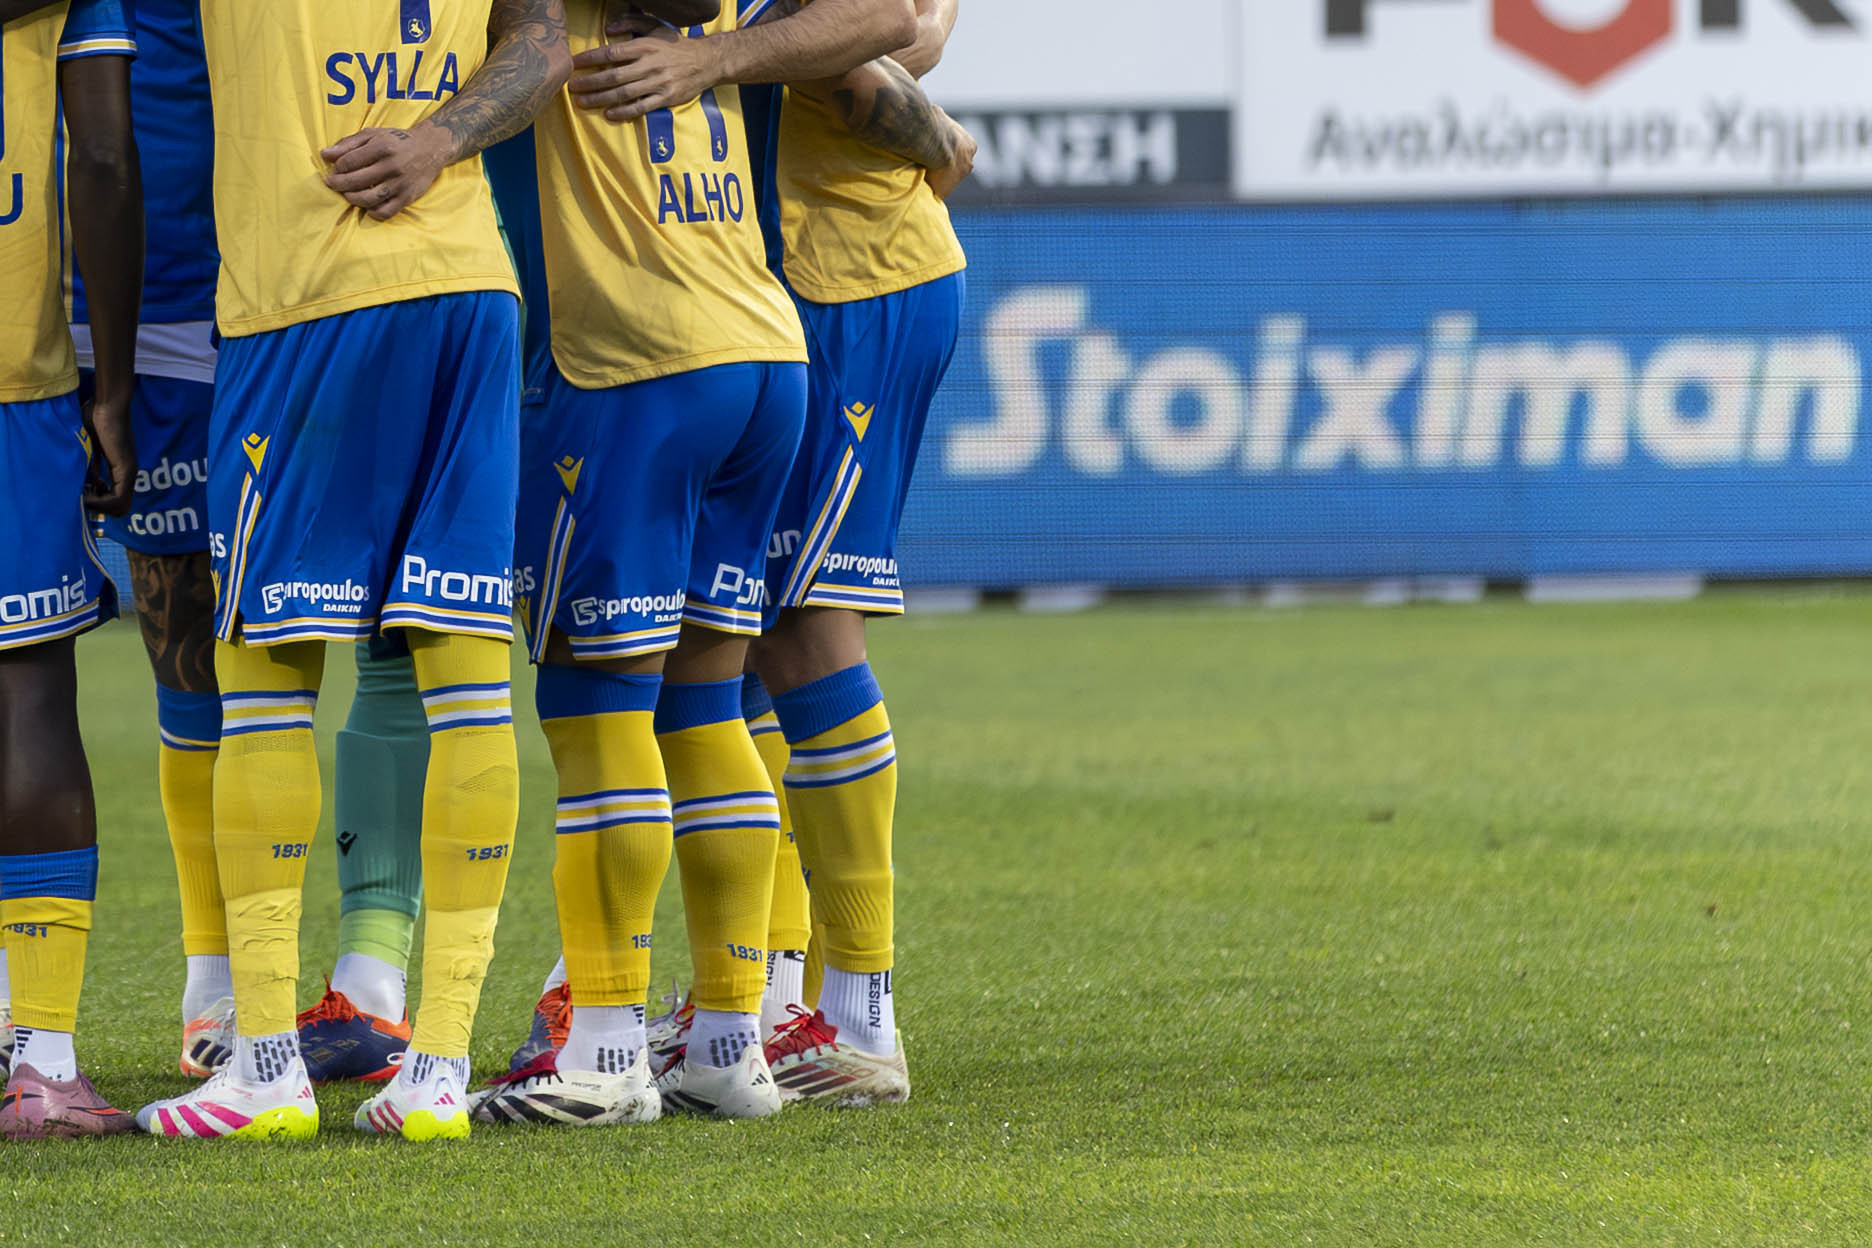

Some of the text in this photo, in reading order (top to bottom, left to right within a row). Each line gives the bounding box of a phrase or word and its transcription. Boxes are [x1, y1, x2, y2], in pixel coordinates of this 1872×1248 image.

[326, 49, 460, 106] SYLLA
[658, 172, 744, 224] ALHO
[942, 284, 1866, 479] Stoiximan
[323, 603, 362, 613] DAIKIN
[272, 843, 308, 858] 1931
[466, 843, 509, 861] 1931
[726, 943, 763, 962] 1931
[868, 972, 882, 1028] DESIGN
